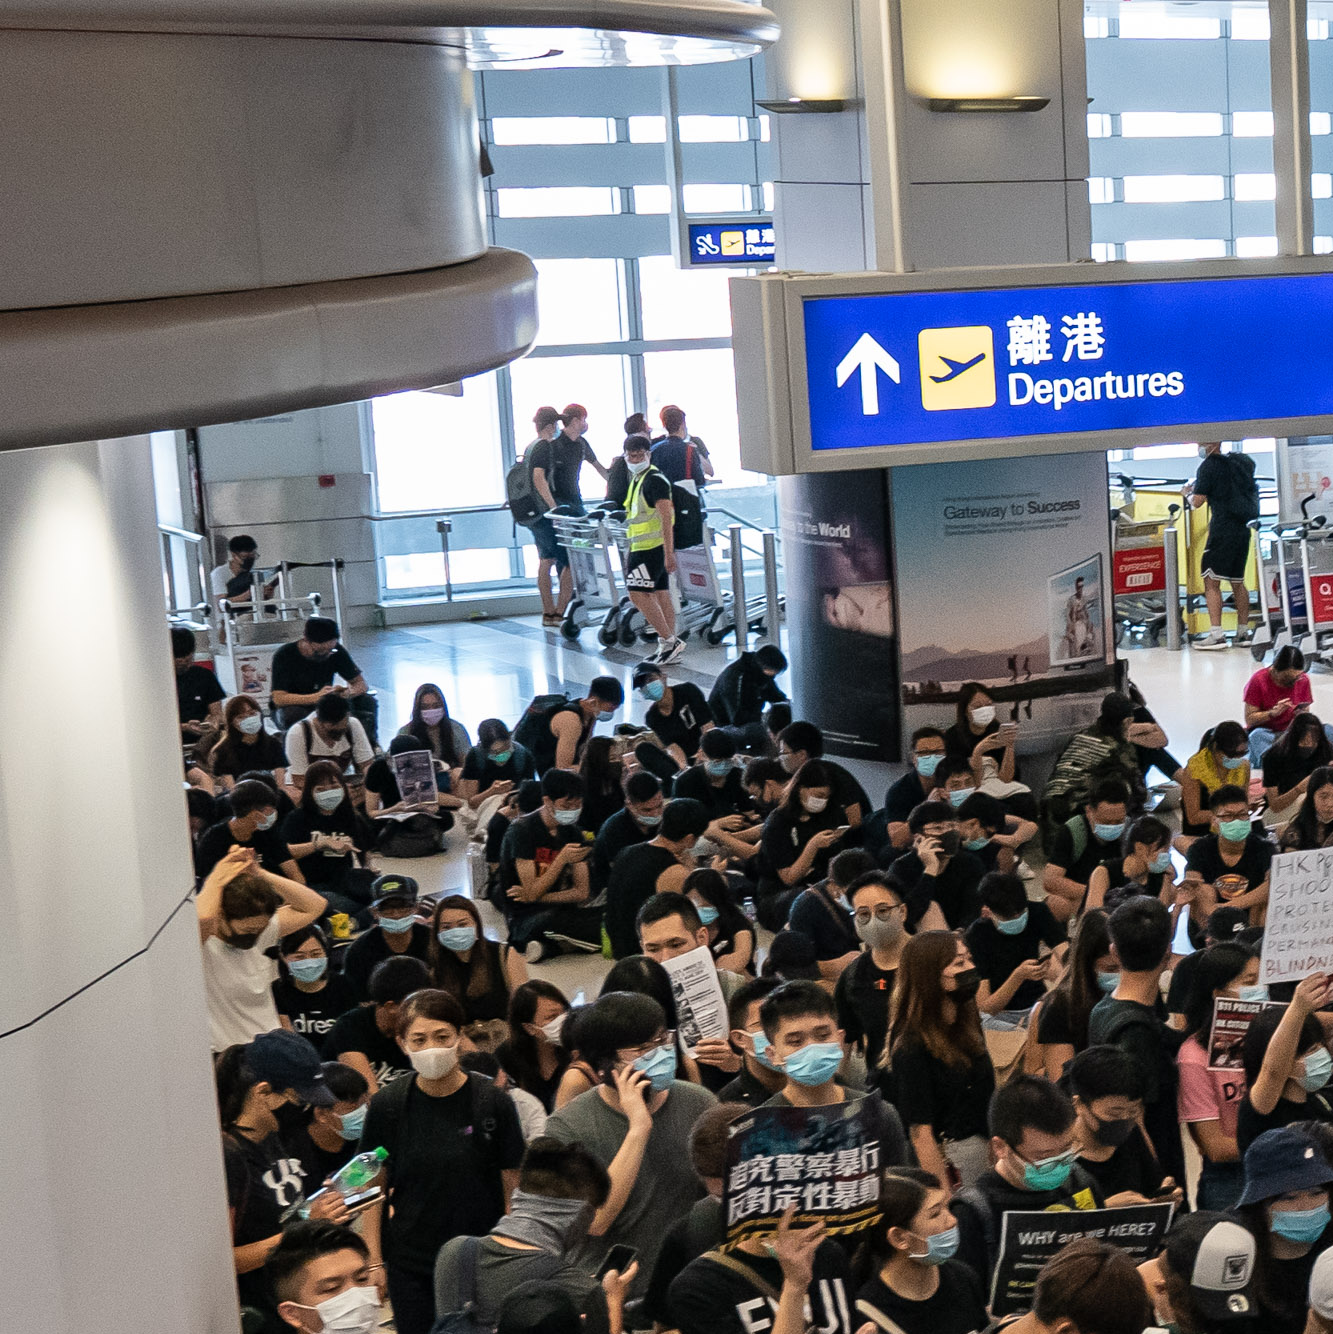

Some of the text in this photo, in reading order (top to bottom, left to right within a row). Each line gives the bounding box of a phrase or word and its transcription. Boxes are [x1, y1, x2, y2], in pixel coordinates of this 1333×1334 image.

[1006, 311, 1106, 366] 離港
[1008, 370, 1185, 410] Departures
[944, 499, 1081, 521] Gateway to Success
[819, 524, 851, 539] World
[1275, 854, 1311, 878] HK
[1233, 1003, 1261, 1013] POLICE
[728, 1141, 881, 1191] 追究警察暴行
[728, 1174, 880, 1226] 反對定性暴動
[1018, 1222, 1157, 1245] WHY are we HERE?
